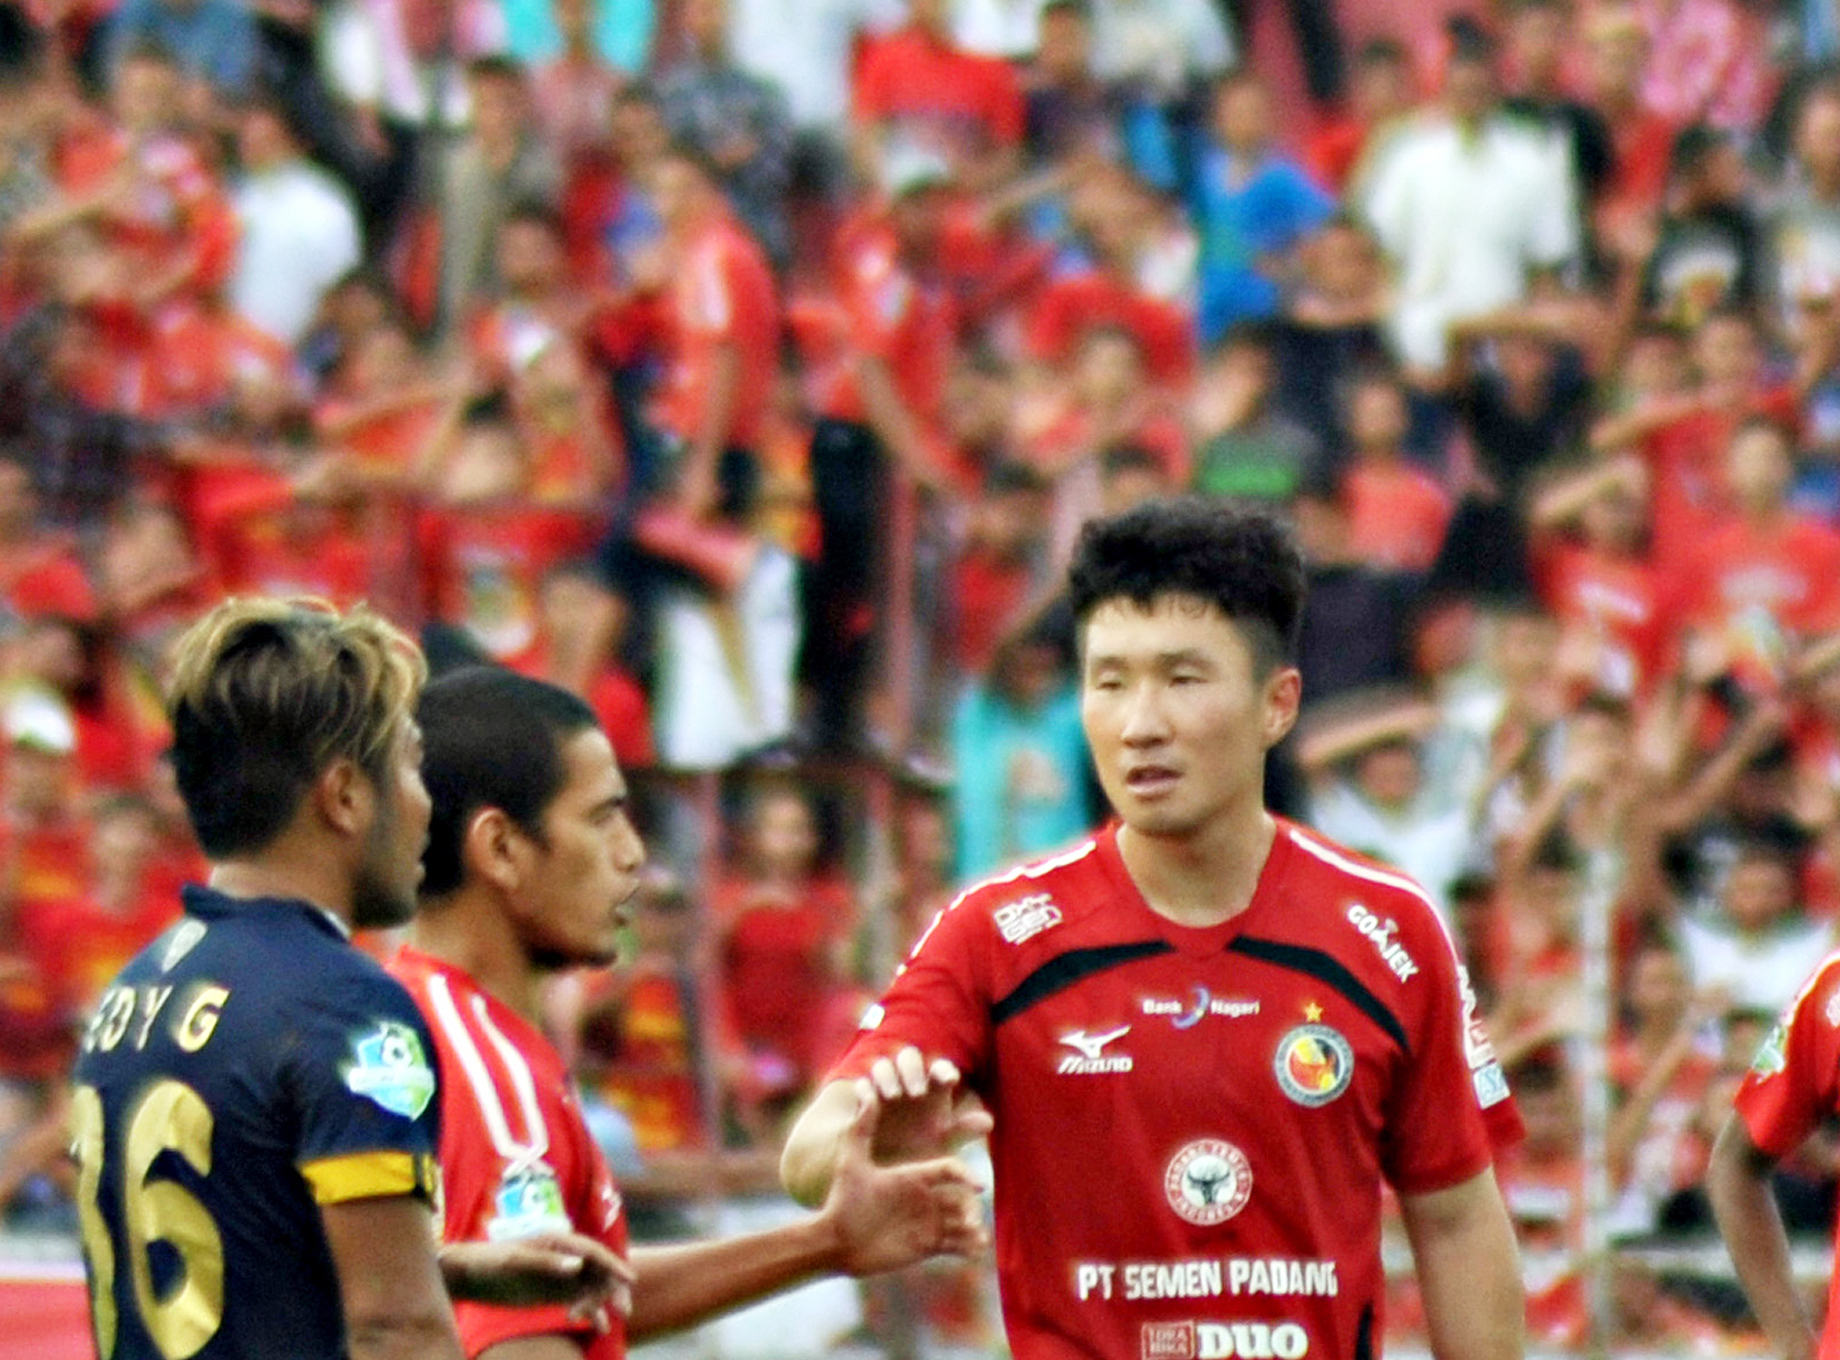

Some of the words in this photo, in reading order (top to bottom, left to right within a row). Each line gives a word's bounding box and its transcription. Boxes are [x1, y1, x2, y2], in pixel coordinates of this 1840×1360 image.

[178, 985, 230, 1053] G
[1077, 1263, 1115, 1300] PT
[1124, 1261, 1223, 1300] SEMEN
[1229, 1260, 1339, 1298] PADANG
[1197, 1322, 1309, 1360] DUO
